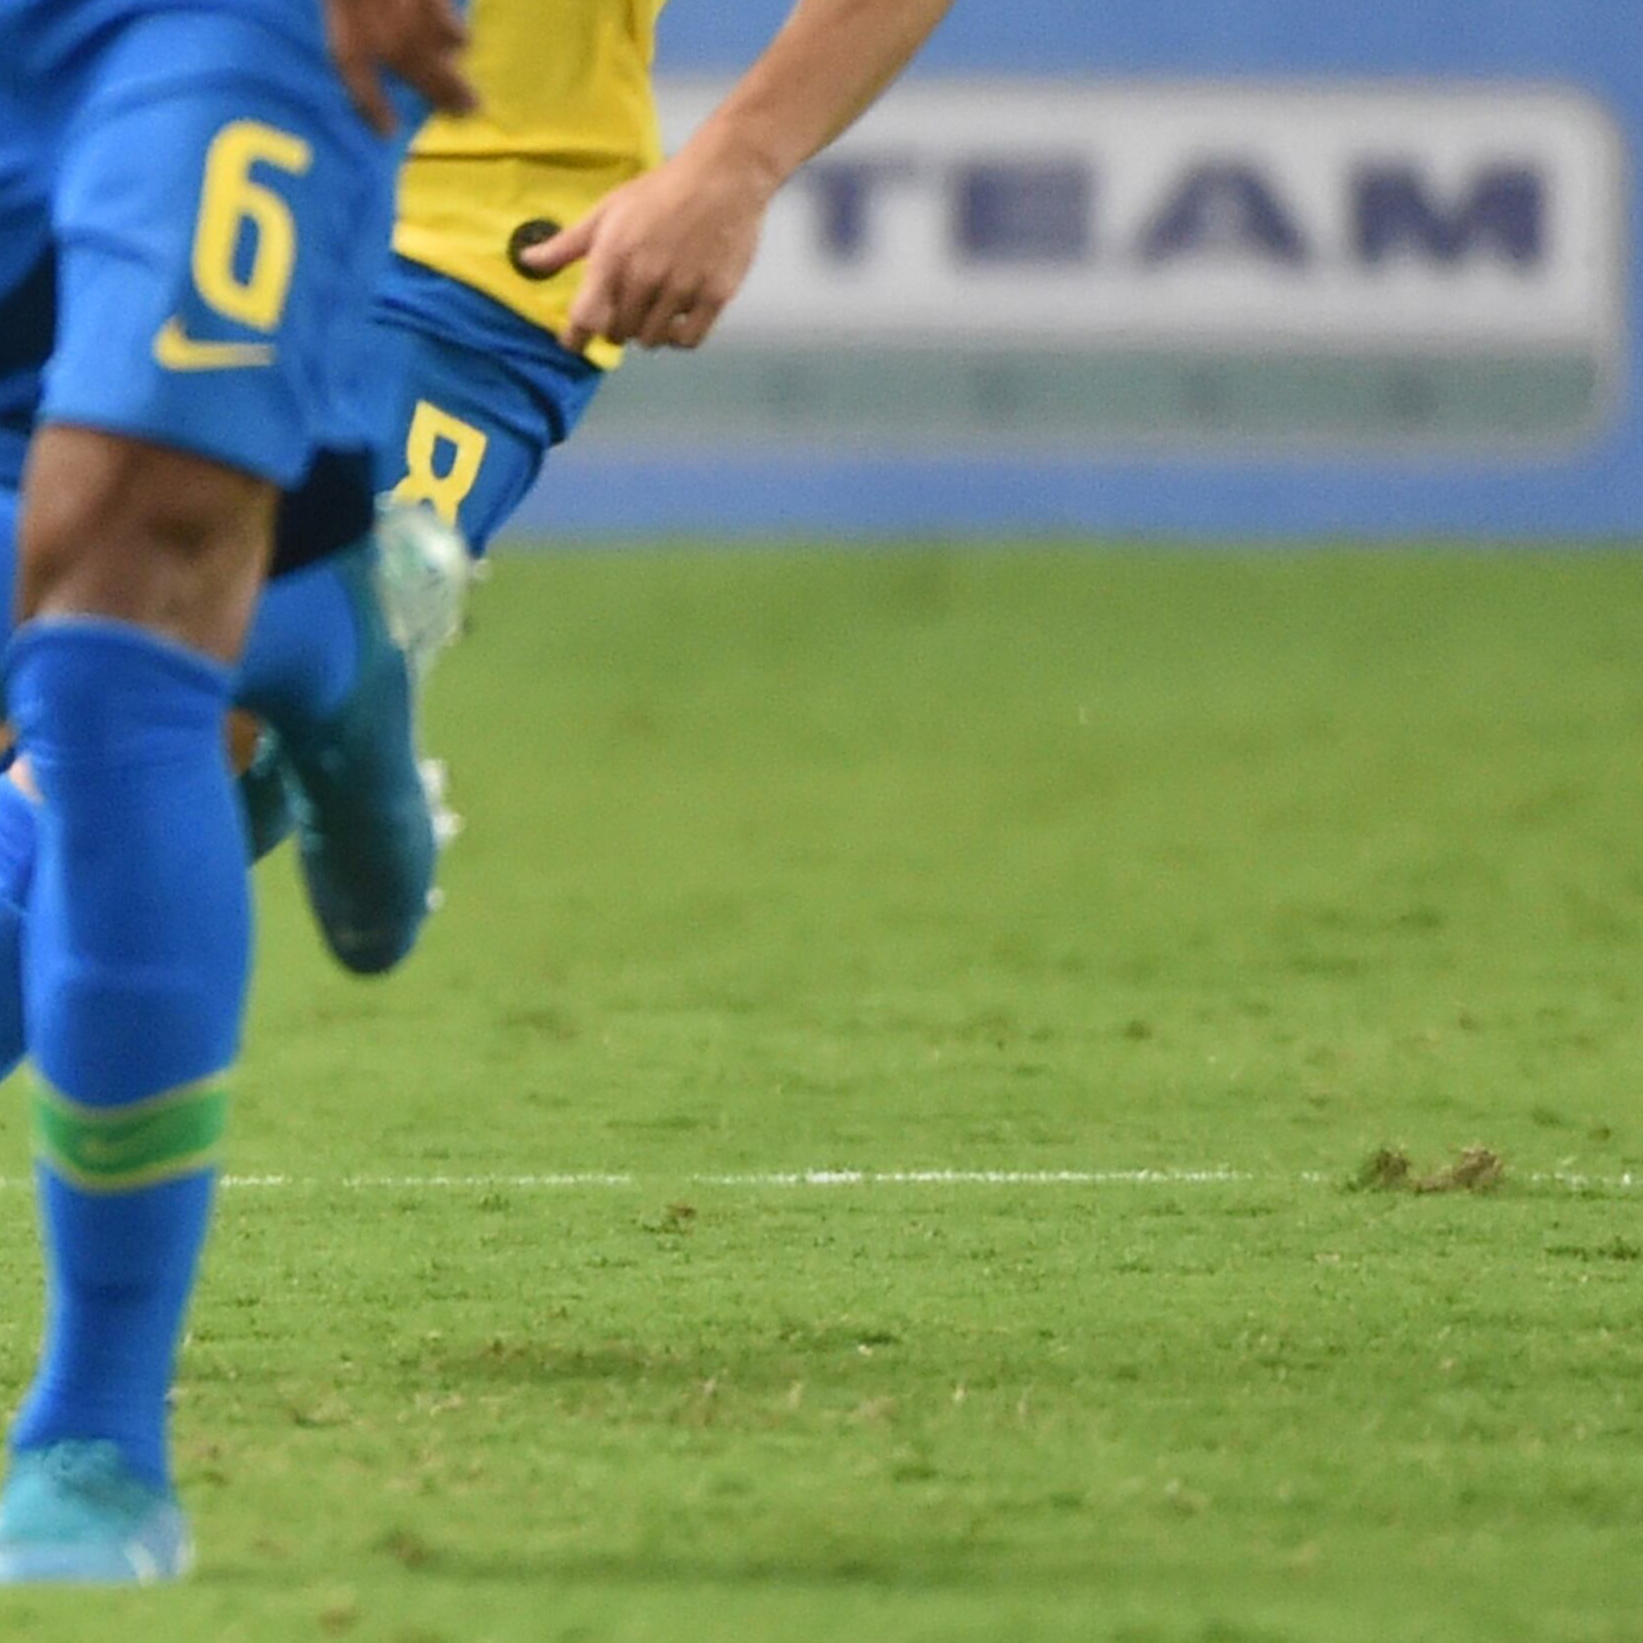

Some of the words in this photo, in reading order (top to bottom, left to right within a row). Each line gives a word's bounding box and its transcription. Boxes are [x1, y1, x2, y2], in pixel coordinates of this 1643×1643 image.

[192, 119, 309, 332] 6
[801, 151, 1547, 270] TEAM
[393, 399, 488, 527] 8
